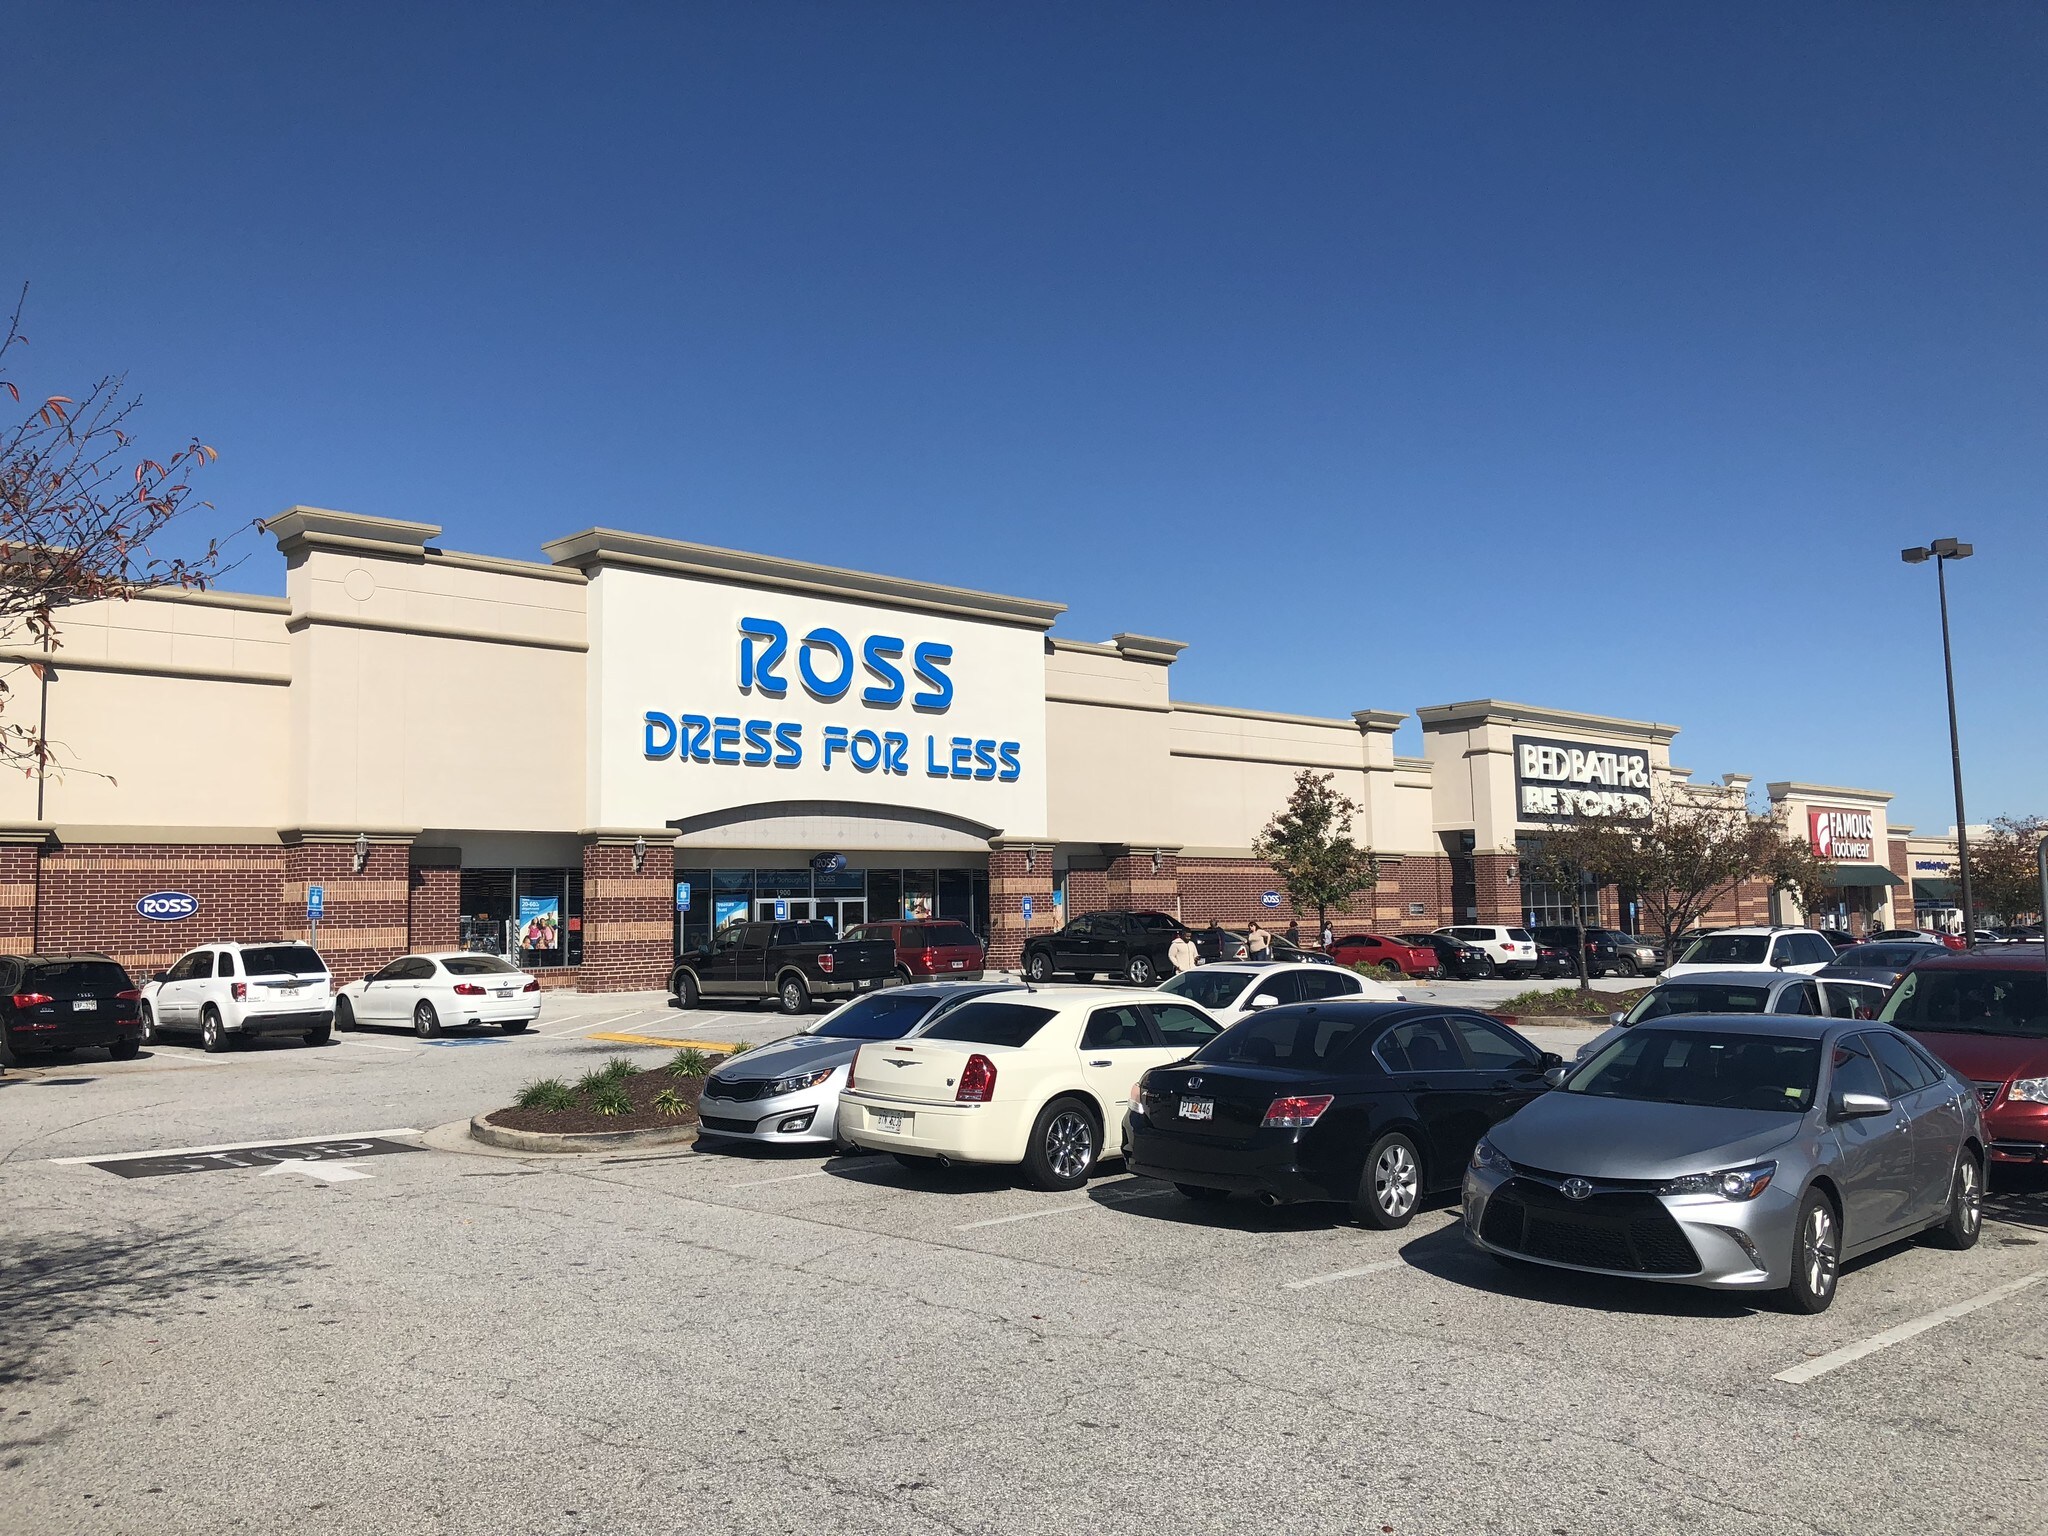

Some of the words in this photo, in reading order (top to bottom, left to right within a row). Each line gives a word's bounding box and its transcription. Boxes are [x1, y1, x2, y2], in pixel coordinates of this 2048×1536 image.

[738, 616, 954, 713] ROSS
[643, 711, 802, 767] DRESS
[823, 726, 909, 774] FOR
[927, 735, 1021, 782] LESS
[1829, 812, 1873, 839] FAMOUS
[1831, 837, 1870, 858] footwear
[816, 857, 837, 868] ROSS
[143, 899, 193, 913] ROSS
[1263, 895, 1280, 903] ROSS
